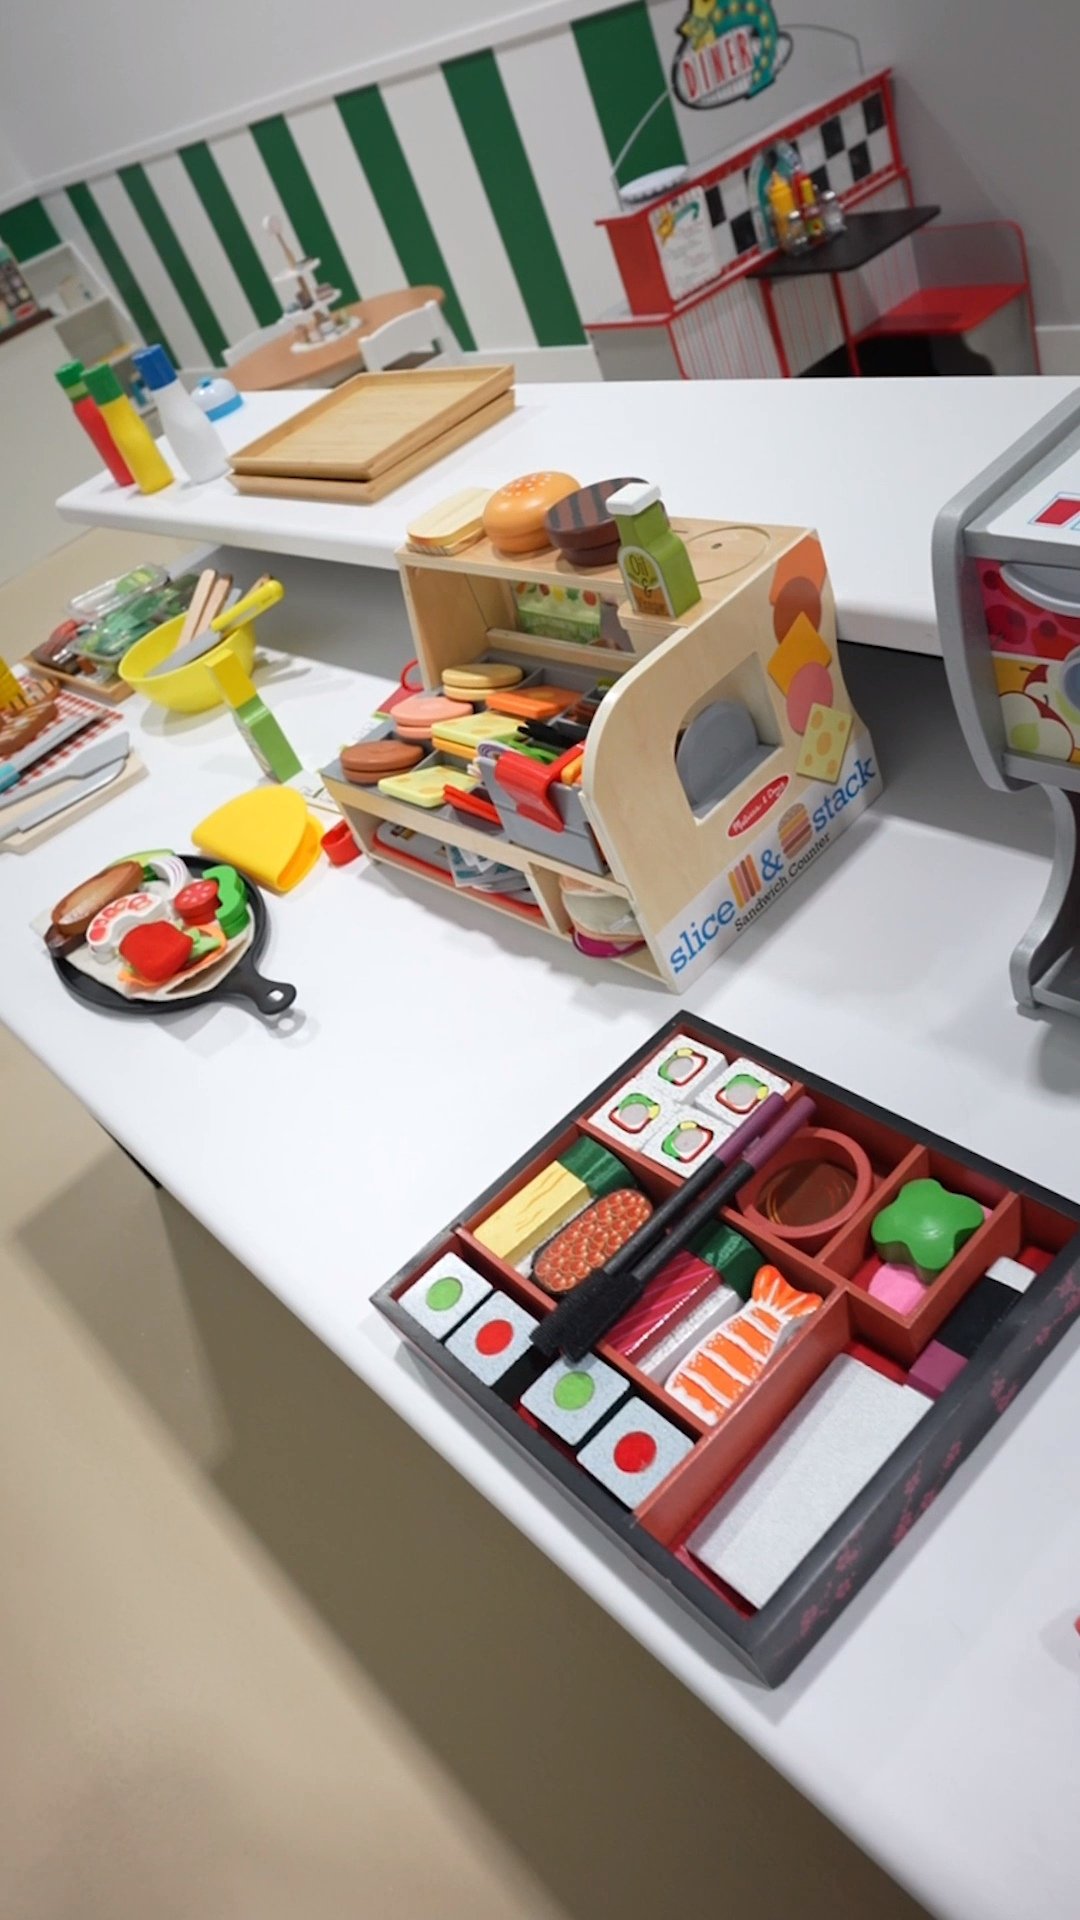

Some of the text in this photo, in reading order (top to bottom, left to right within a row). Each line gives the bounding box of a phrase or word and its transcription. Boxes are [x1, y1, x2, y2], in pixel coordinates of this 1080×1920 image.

[682, 31, 753, 98] DINER
[629, 553, 649, 577] Oil
[670, 757, 876, 973] slice & stack
[734, 875, 789, 932] Sandwich
[788, 832, 831, 877] Counter
